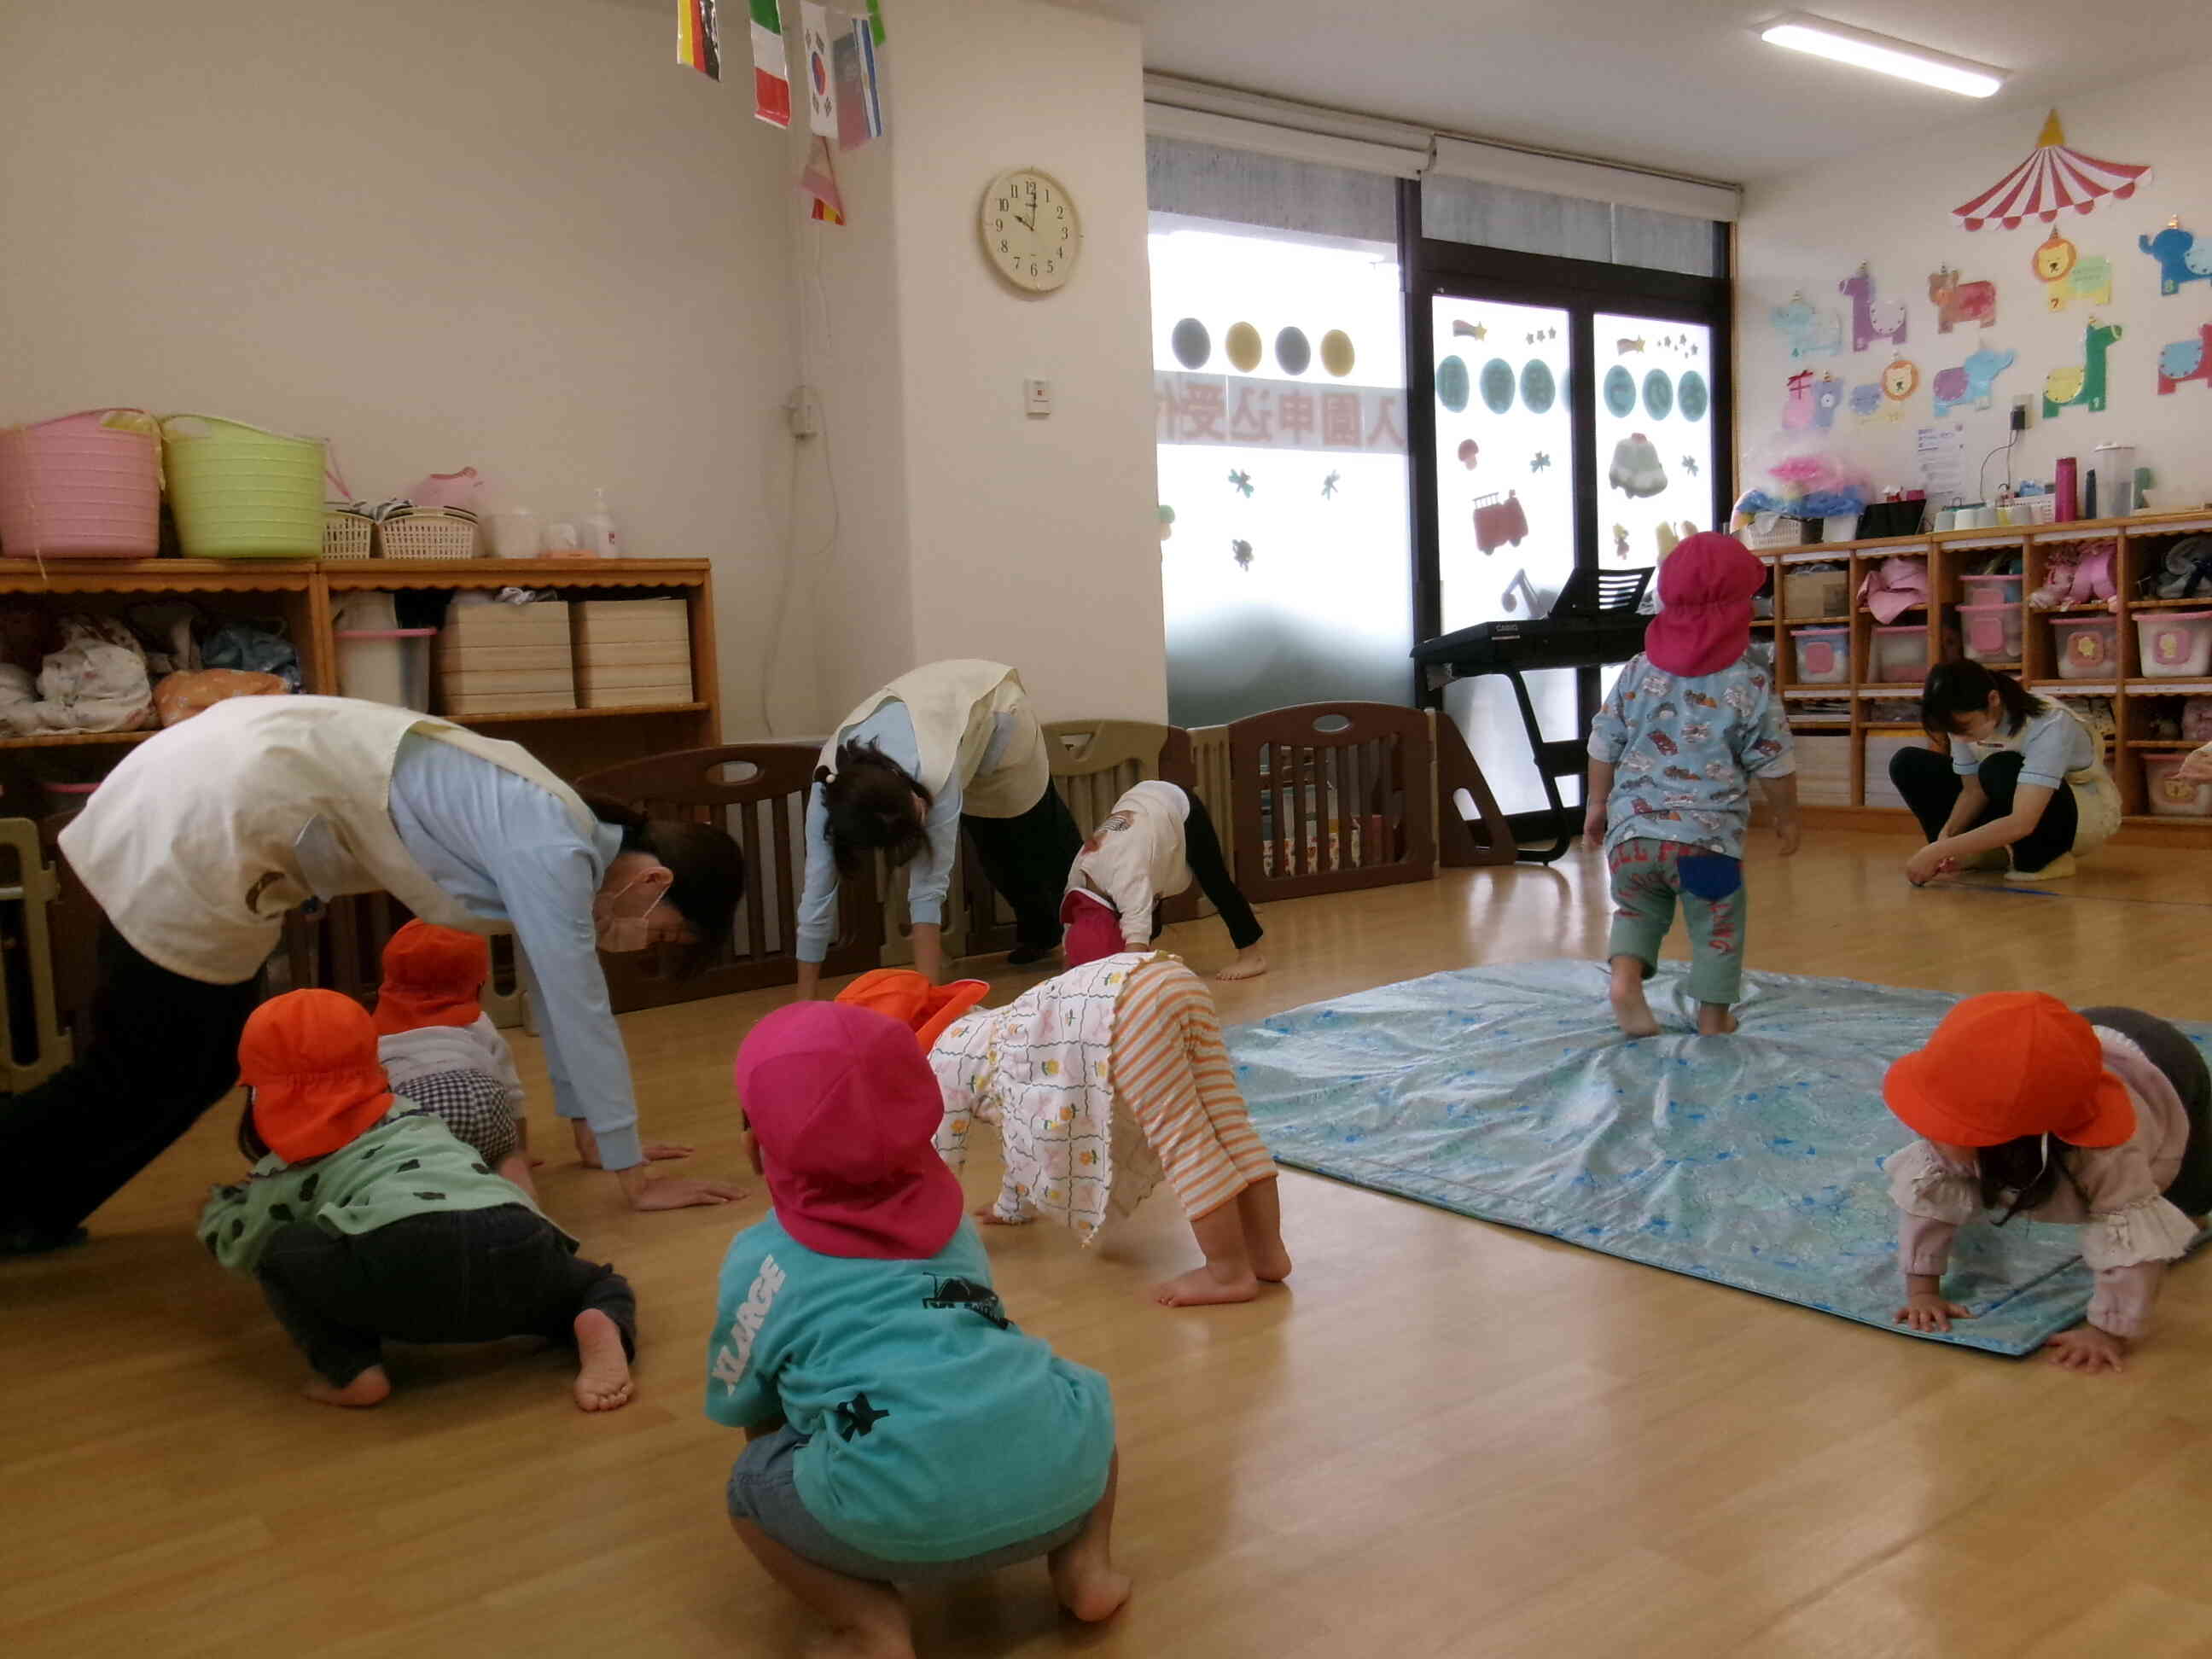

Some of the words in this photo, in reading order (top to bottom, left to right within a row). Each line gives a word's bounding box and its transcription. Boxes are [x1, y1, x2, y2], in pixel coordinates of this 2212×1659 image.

[1010, 183, 1018, 199] 11
[1025, 180, 1037, 195] 12
[1045, 189, 1050, 204] 1
[998, 197, 1010, 212] 10
[1056, 205, 1064, 220] 2
[995, 218, 1004, 233] 9
[1061, 226, 1069, 240] 3
[1000, 238, 1009, 253] 8
[1057, 245, 1063, 259] 4
[1012, 255, 1022, 270] 7
[1046, 259, 1054, 273] 5
[1030, 263, 1039, 278] 6
